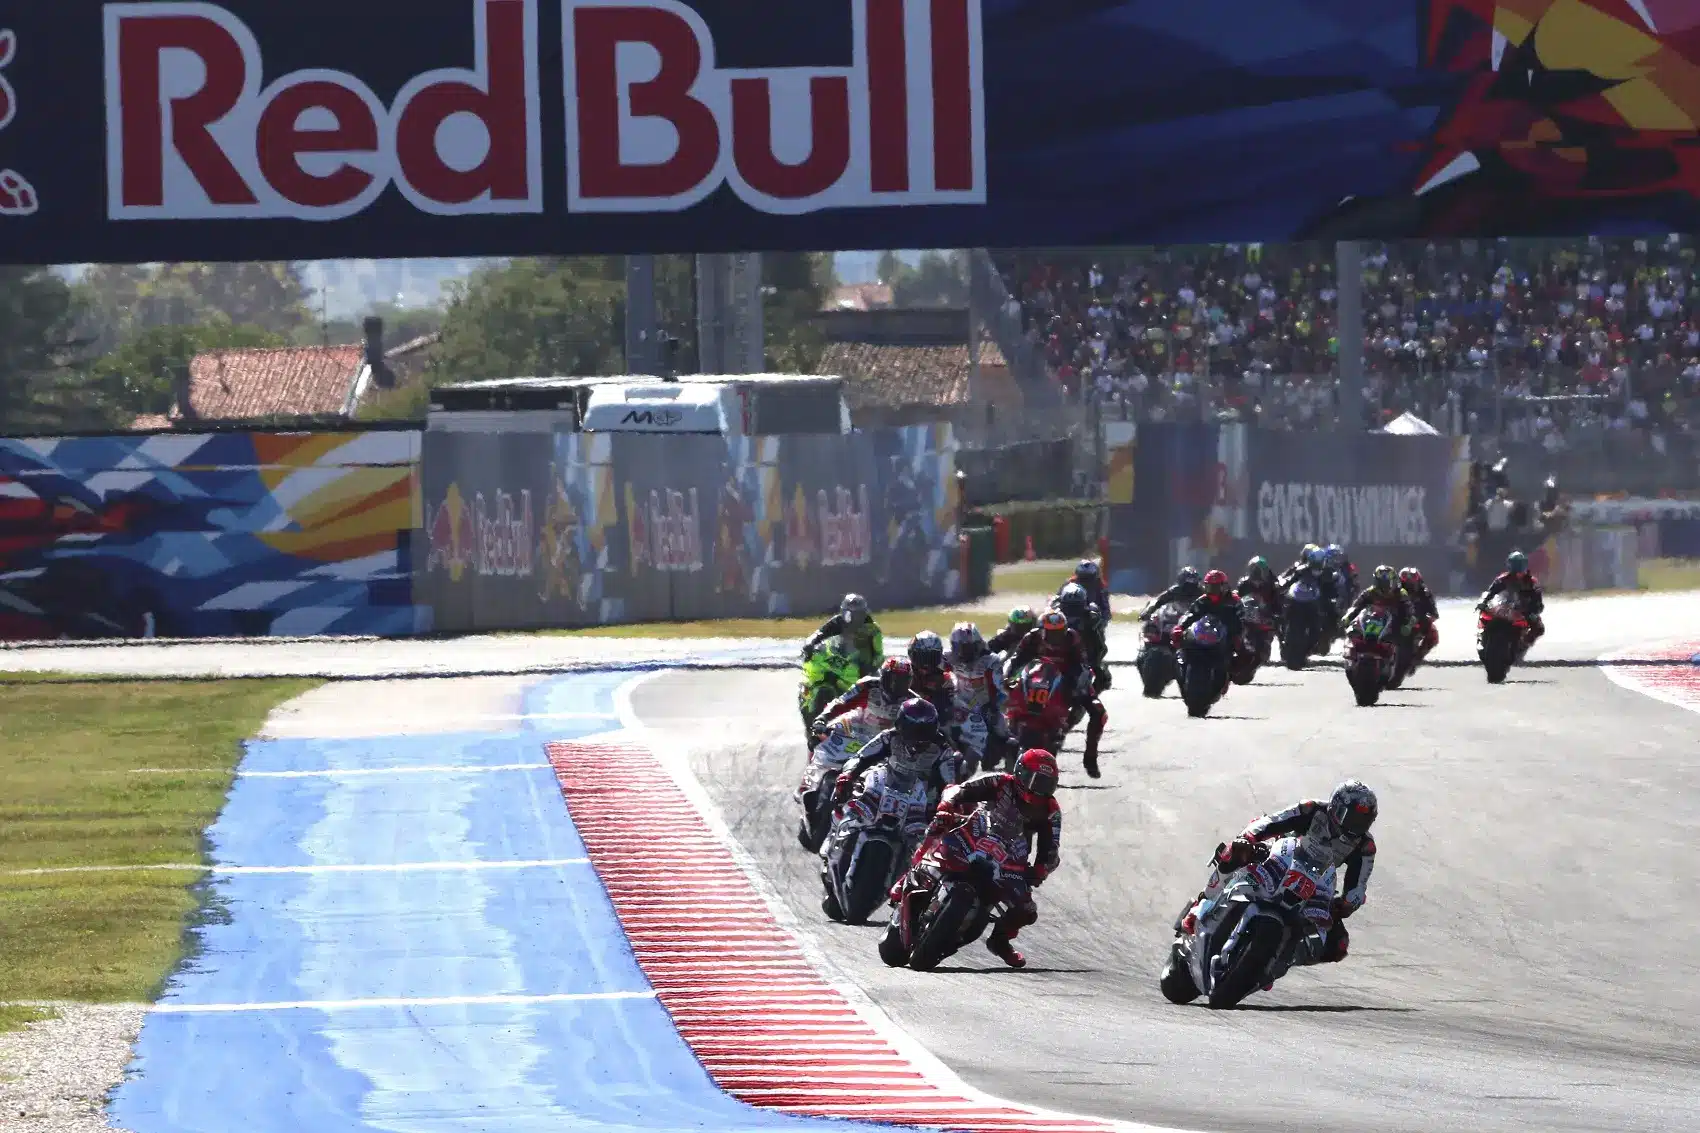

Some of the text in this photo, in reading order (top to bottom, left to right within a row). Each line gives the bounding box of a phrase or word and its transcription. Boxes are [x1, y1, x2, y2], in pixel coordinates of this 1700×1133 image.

[104, 0, 986, 219] Red Bull
[1001, 872, 1023, 881] Lenovo
